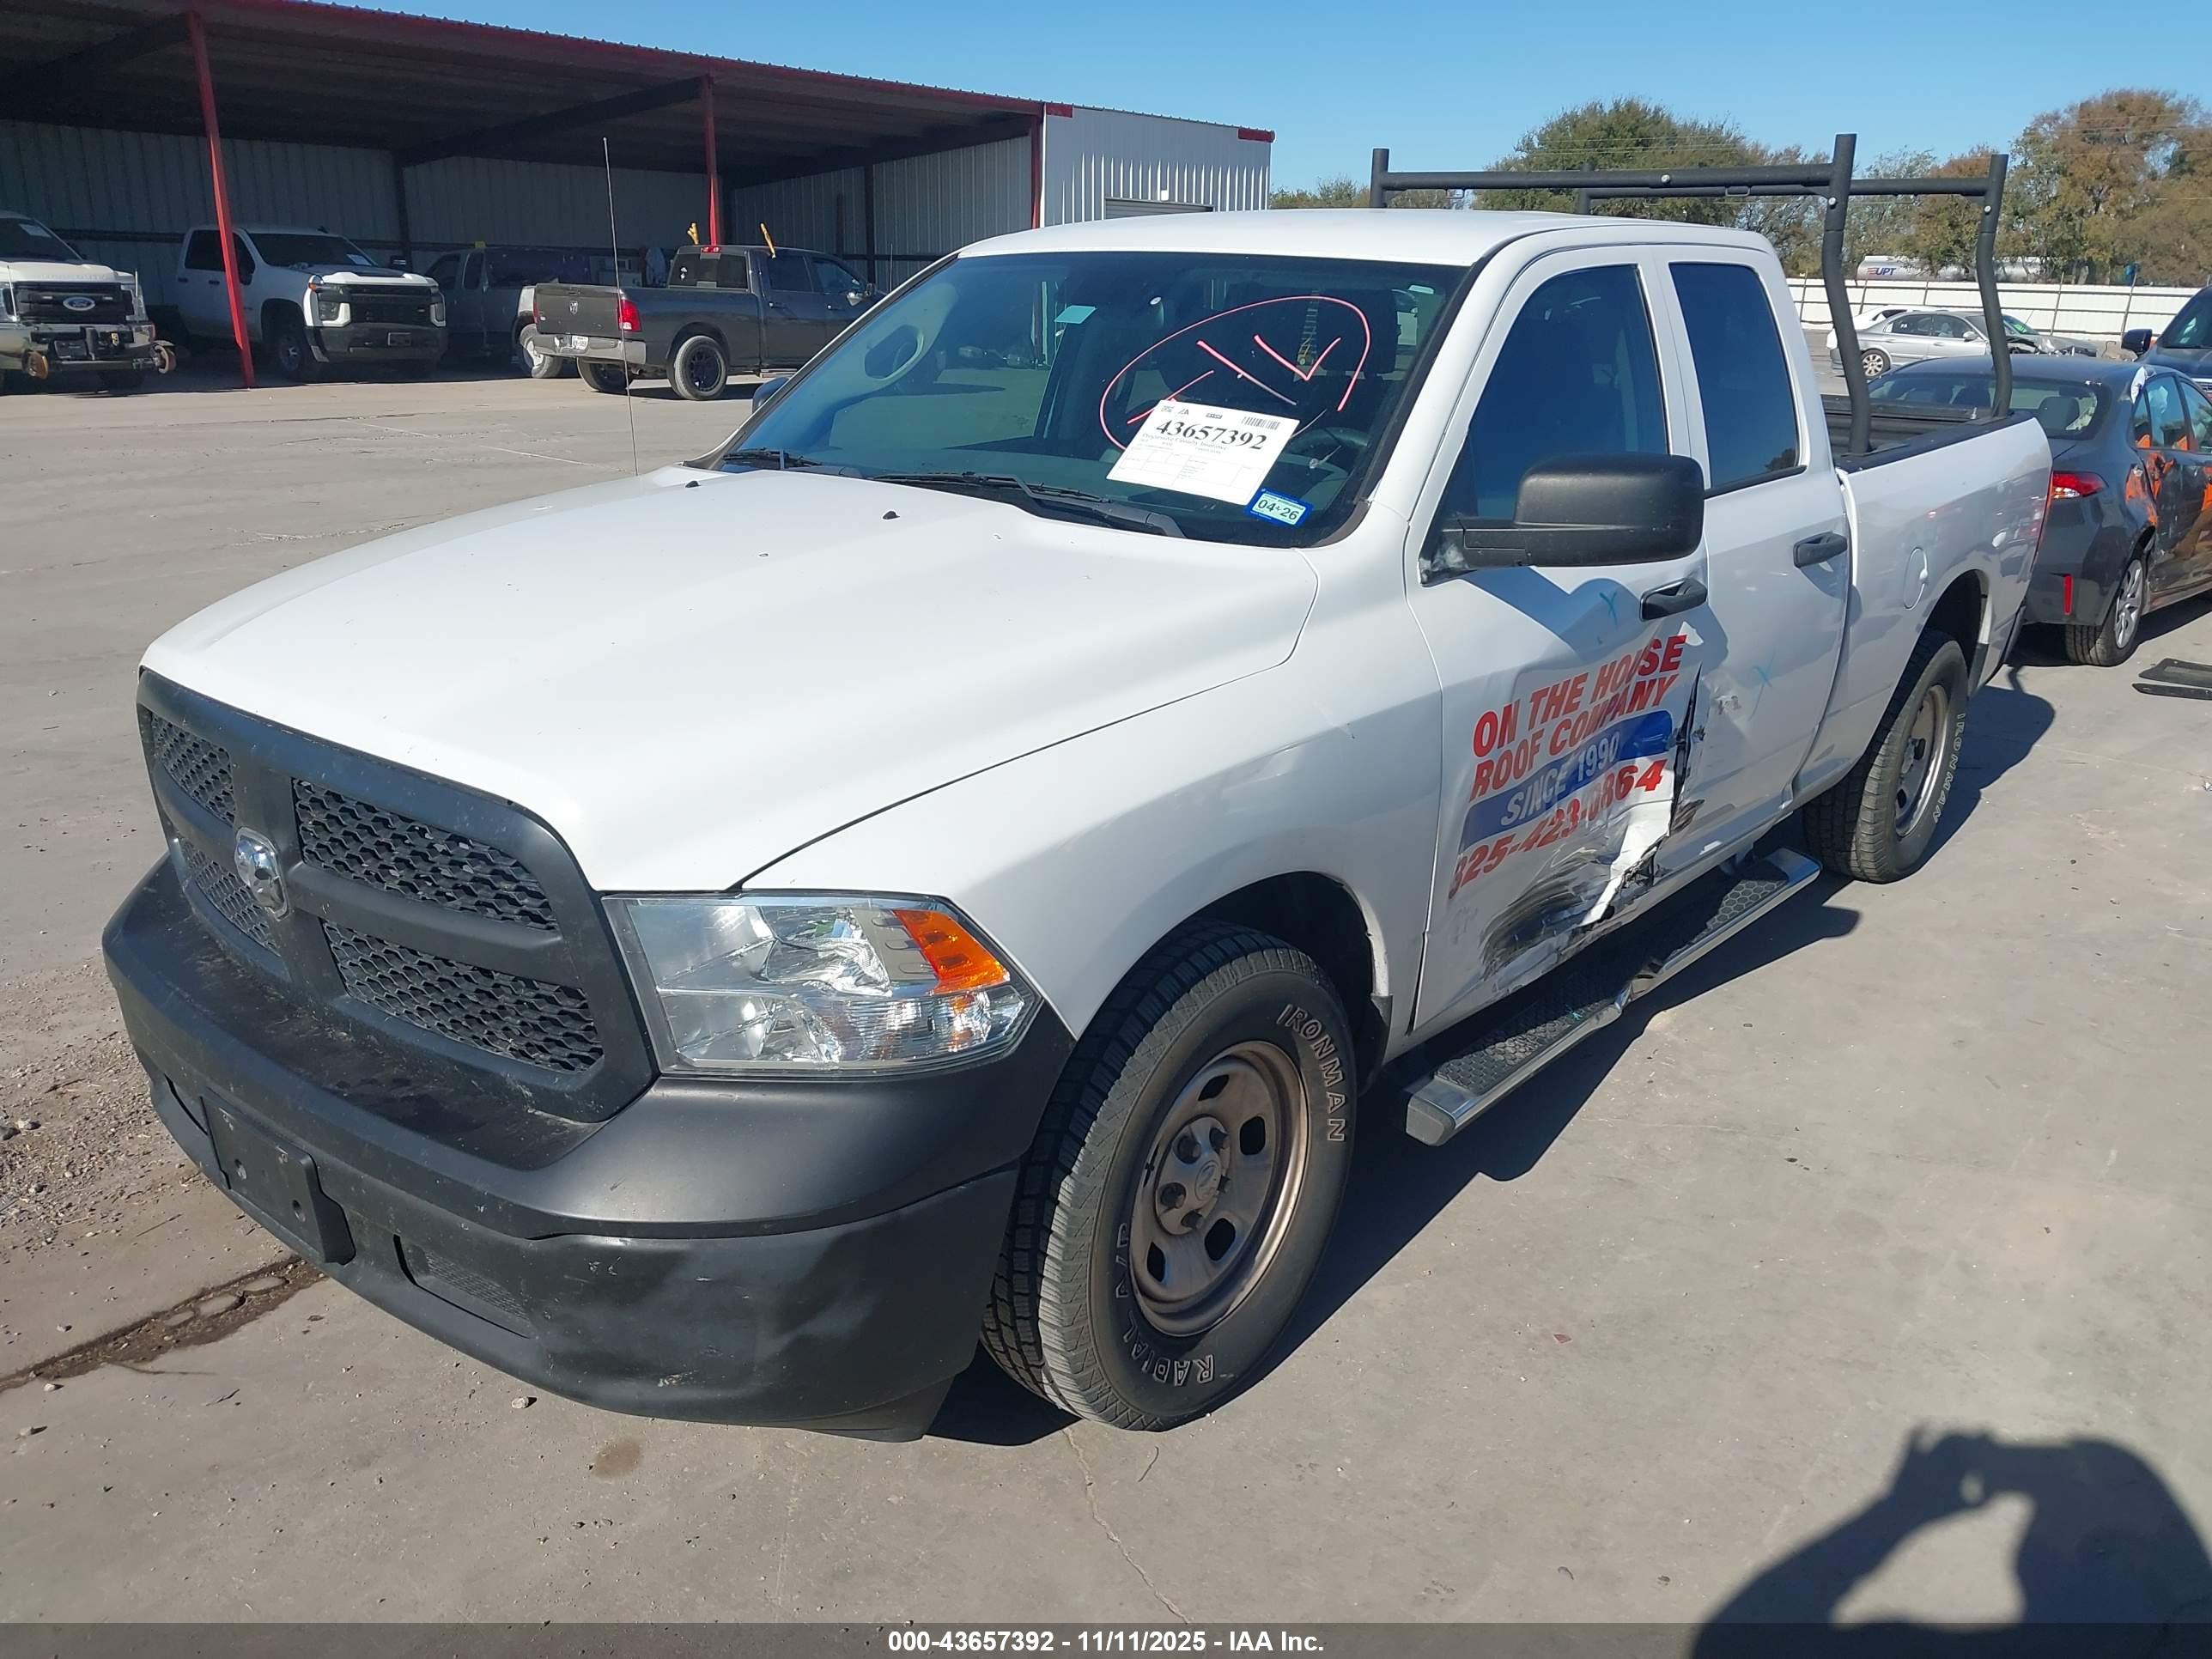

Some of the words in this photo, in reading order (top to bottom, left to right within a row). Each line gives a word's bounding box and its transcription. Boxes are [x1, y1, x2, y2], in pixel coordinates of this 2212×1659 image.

[1156, 419, 1267, 450] 43657392
[1257, 499, 1276, 512] 04
[1279, 507, 1300, 520] 26
[1469, 727, 1545, 802] ROOF
[1548, 673, 1680, 757] COMPANY
[1472, 698, 1521, 757] ON
[1528, 672, 1589, 731] THE
[1500, 760, 1570, 826] SINCE
[1576, 730, 1621, 782] 1990
[1932, 713, 1966, 823] IRONMAN
[1276, 1004, 1346, 1141] IRONMAN
[1122, 1309, 1216, 1387] RADIAL
